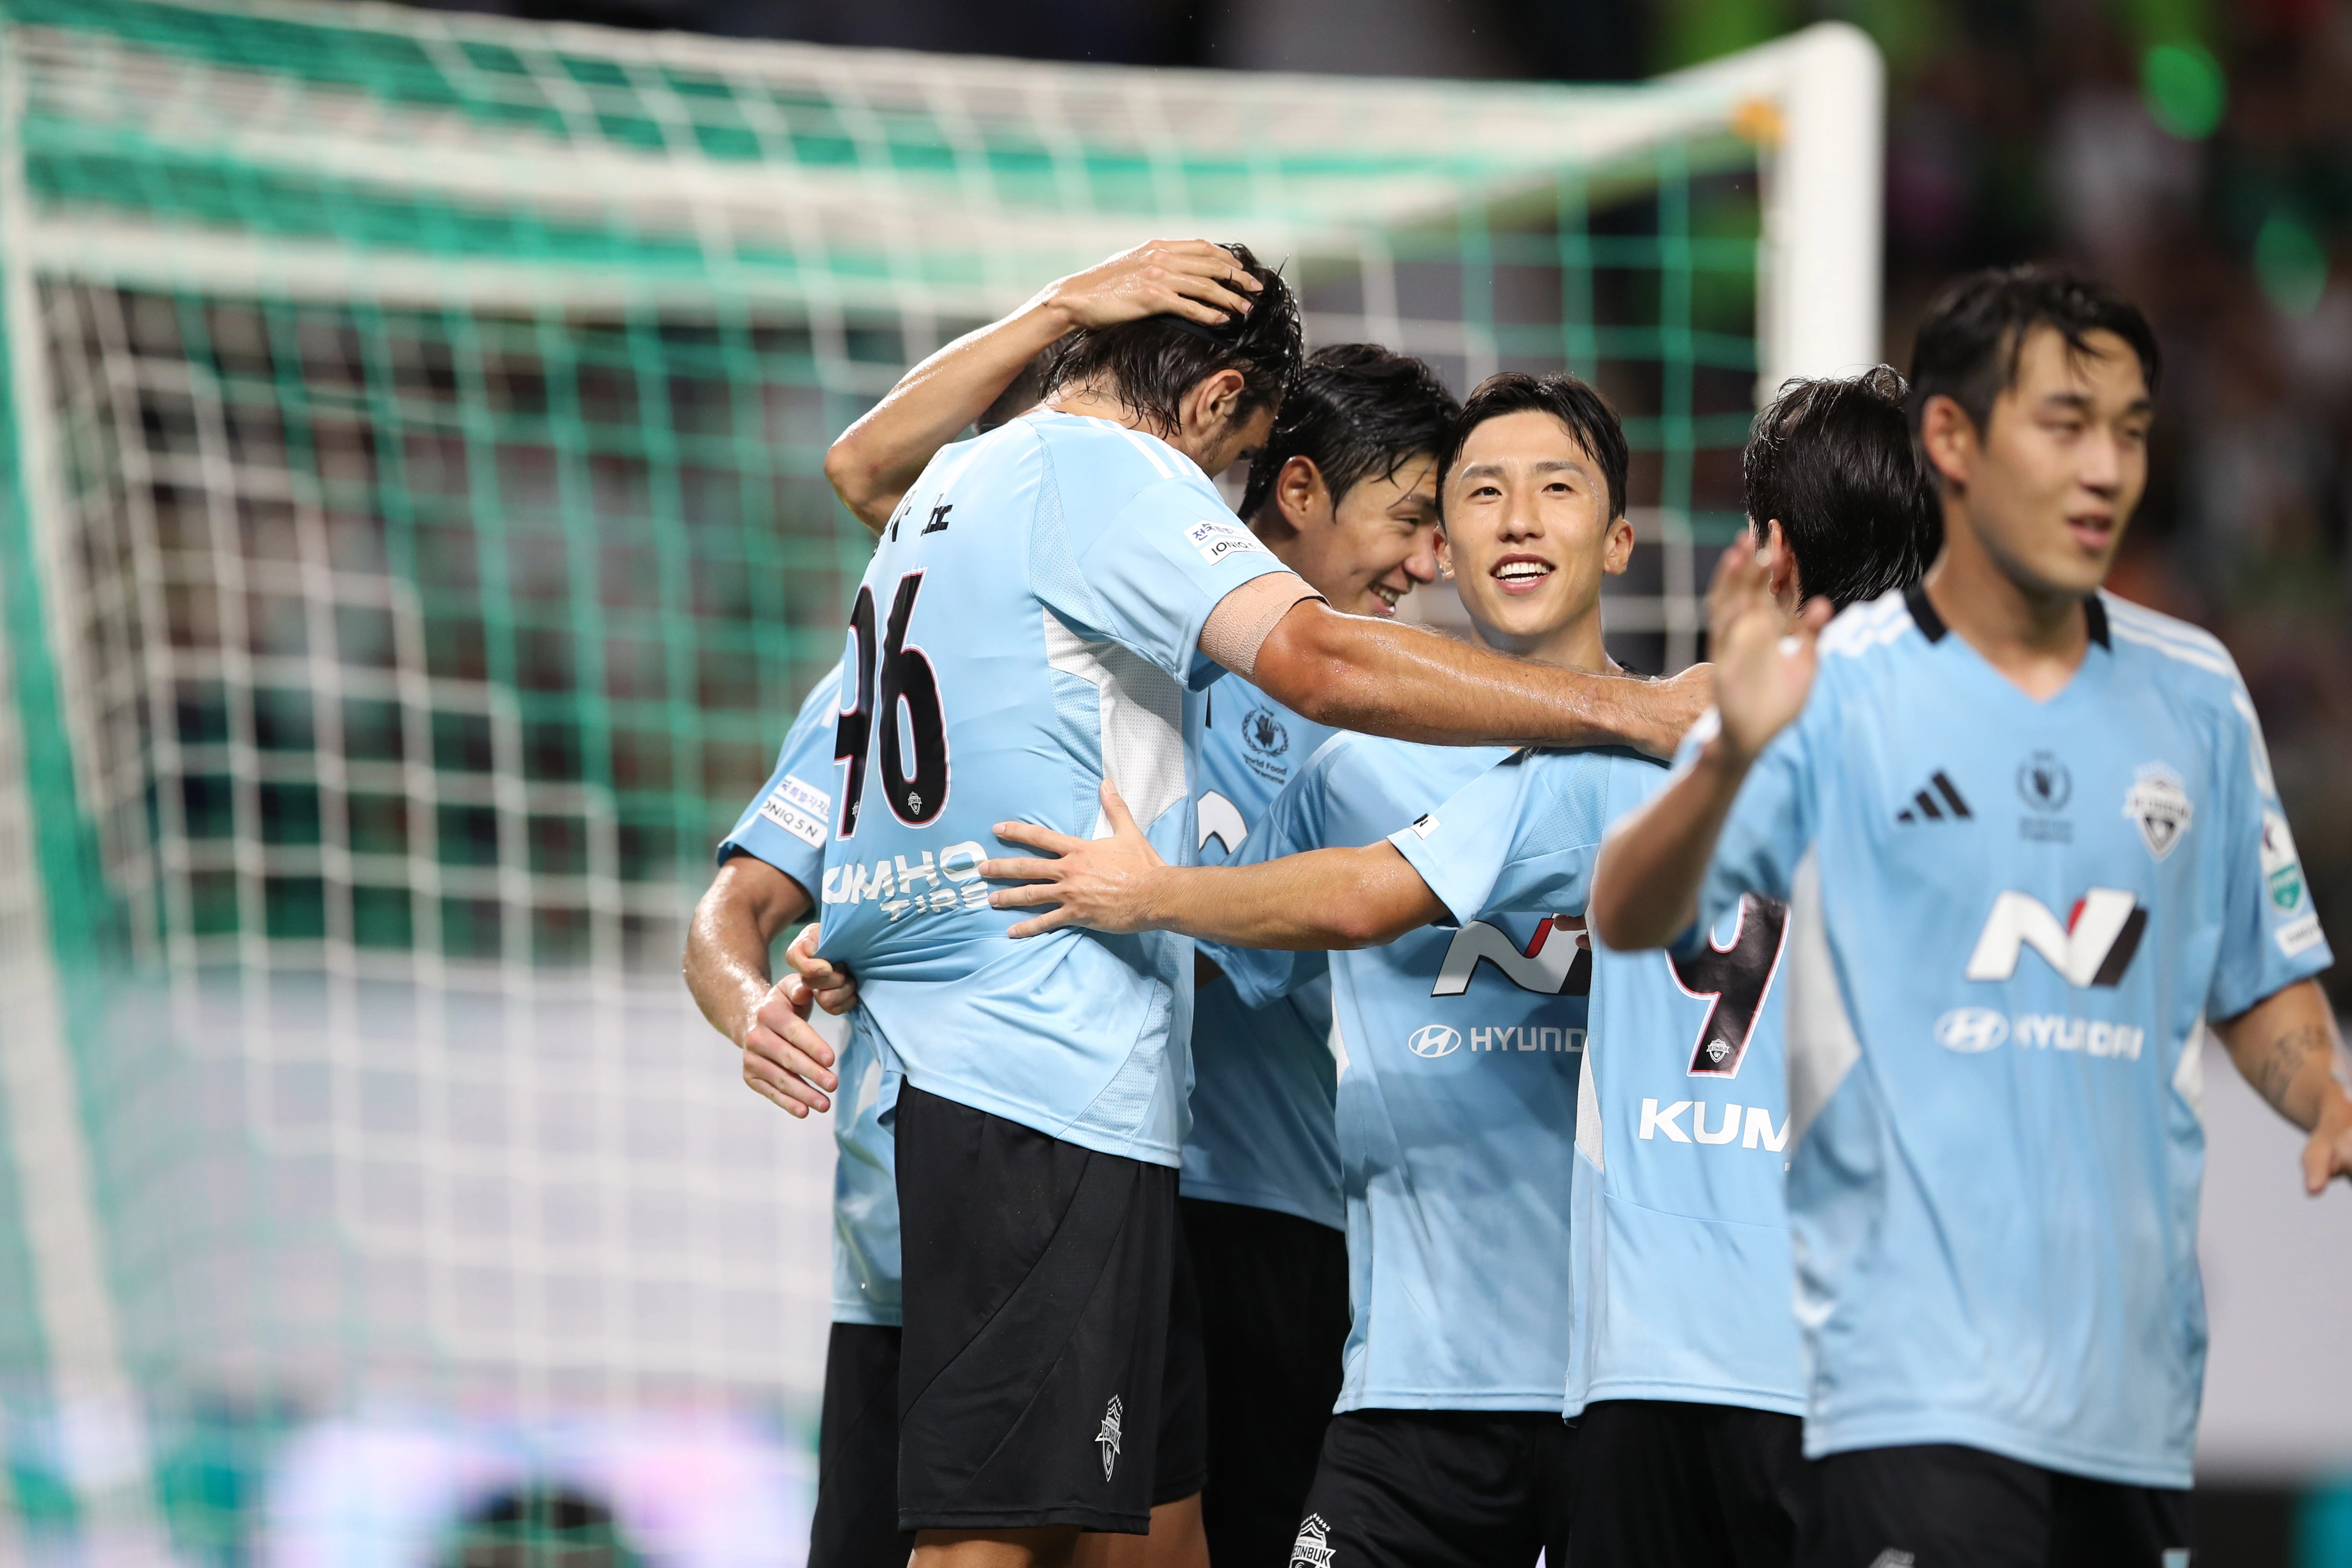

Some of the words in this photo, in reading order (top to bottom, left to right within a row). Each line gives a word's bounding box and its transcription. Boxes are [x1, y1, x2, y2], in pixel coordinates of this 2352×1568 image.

[1211, 541, 1251, 556] IONIQ
[833, 567, 951, 841] 96
[1266, 763, 1287, 775] Food
[763, 800, 794, 825] ONIQ
[794, 818, 806, 830] 5
[804, 824, 818, 837] N
[821, 840, 989, 905] UMHO
[1470, 1026, 1588, 1053] HYUND
[1638, 1097, 1792, 1153] KUM
[1292, 1546, 1331, 1567] EONBUK
